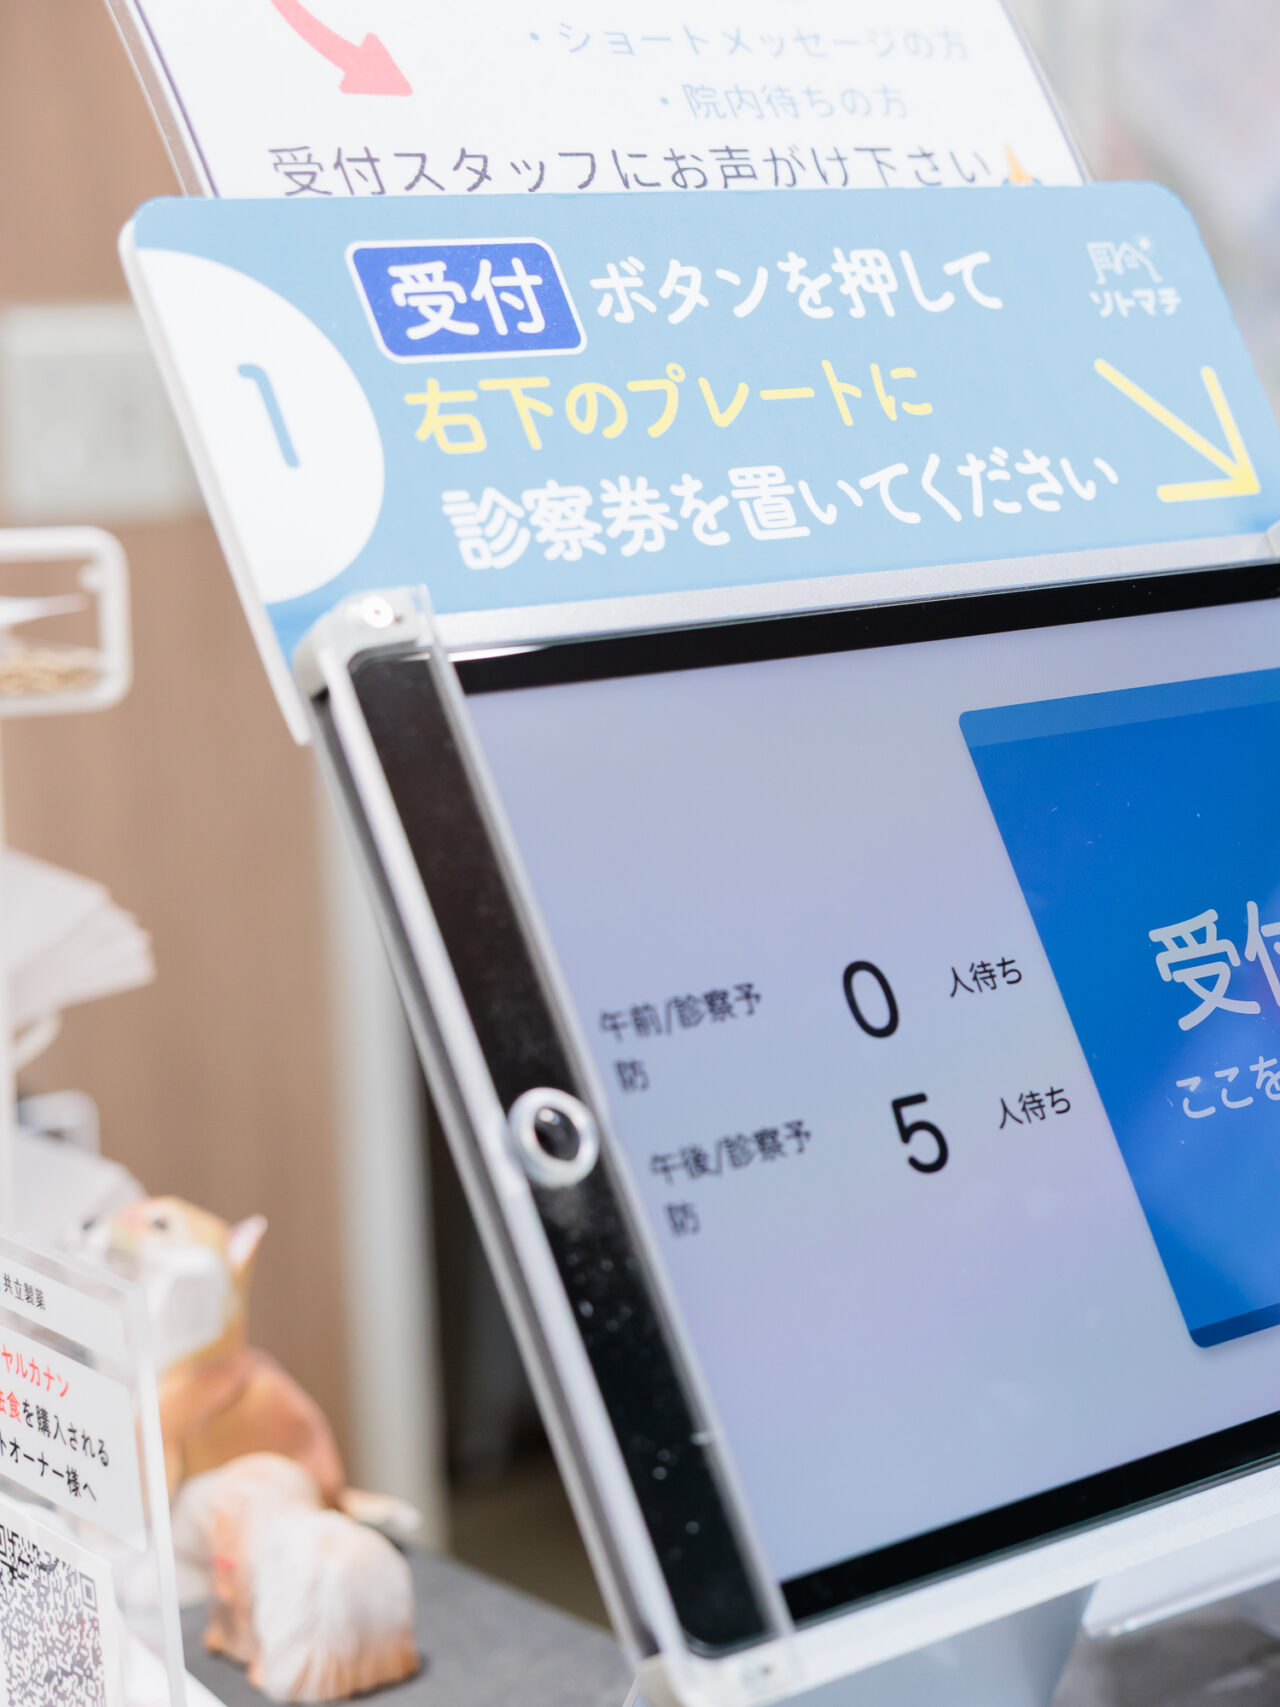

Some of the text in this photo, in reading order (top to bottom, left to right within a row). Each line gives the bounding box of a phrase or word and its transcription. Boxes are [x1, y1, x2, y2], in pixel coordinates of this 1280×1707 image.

[267, 144, 992, 197] 受付スタッフにお声がけ下さい
[387, 247, 1004, 341] 受付 ボタンを押して
[1088, 286, 1183, 319] ソトマチ
[236, 362, 301, 469] 1
[404, 359, 934, 455] 右下のプレートに
[440, 446, 1120, 571] 診察券を置いてください
[842, 960, 900, 1039] 0
[948, 956, 1024, 999] 人待ち
[891, 1092, 950, 1175] 5
[997, 1085, 1073, 1131] 人待ち
[3, 1272, 47, 1311] 共立製薬
